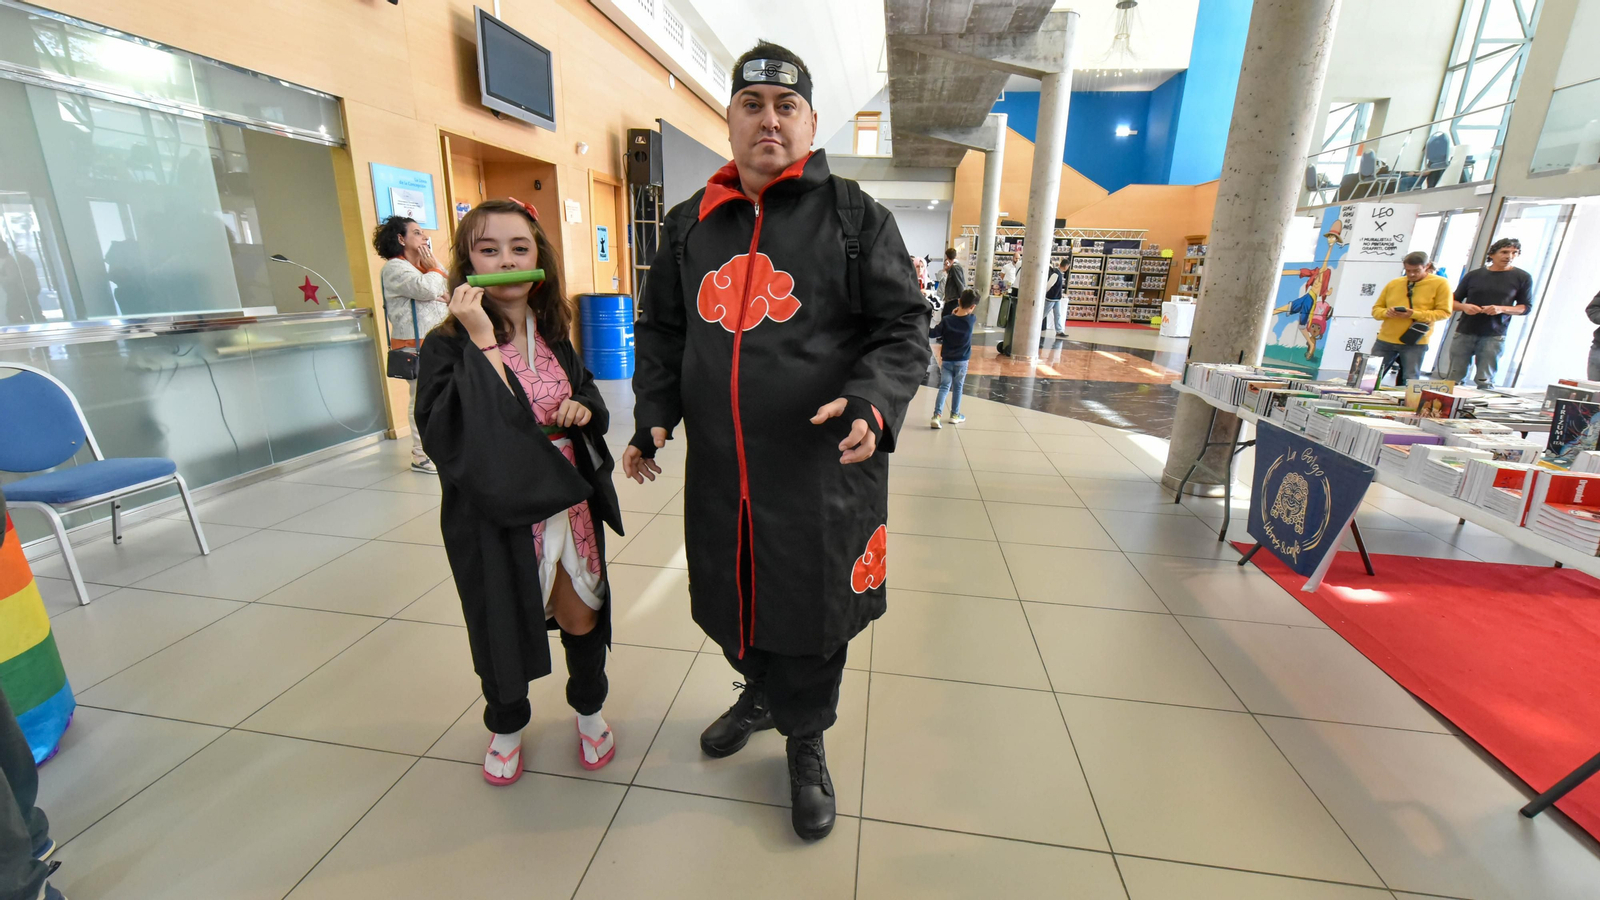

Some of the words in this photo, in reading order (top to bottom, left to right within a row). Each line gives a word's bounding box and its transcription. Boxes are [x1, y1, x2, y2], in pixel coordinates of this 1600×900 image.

[1372, 206, 1394, 218] LEO
[1413, 384, 1450, 394] ECHO
[1554, 404, 1566, 440] IREZUMI
[1286, 446, 1297, 462] La
